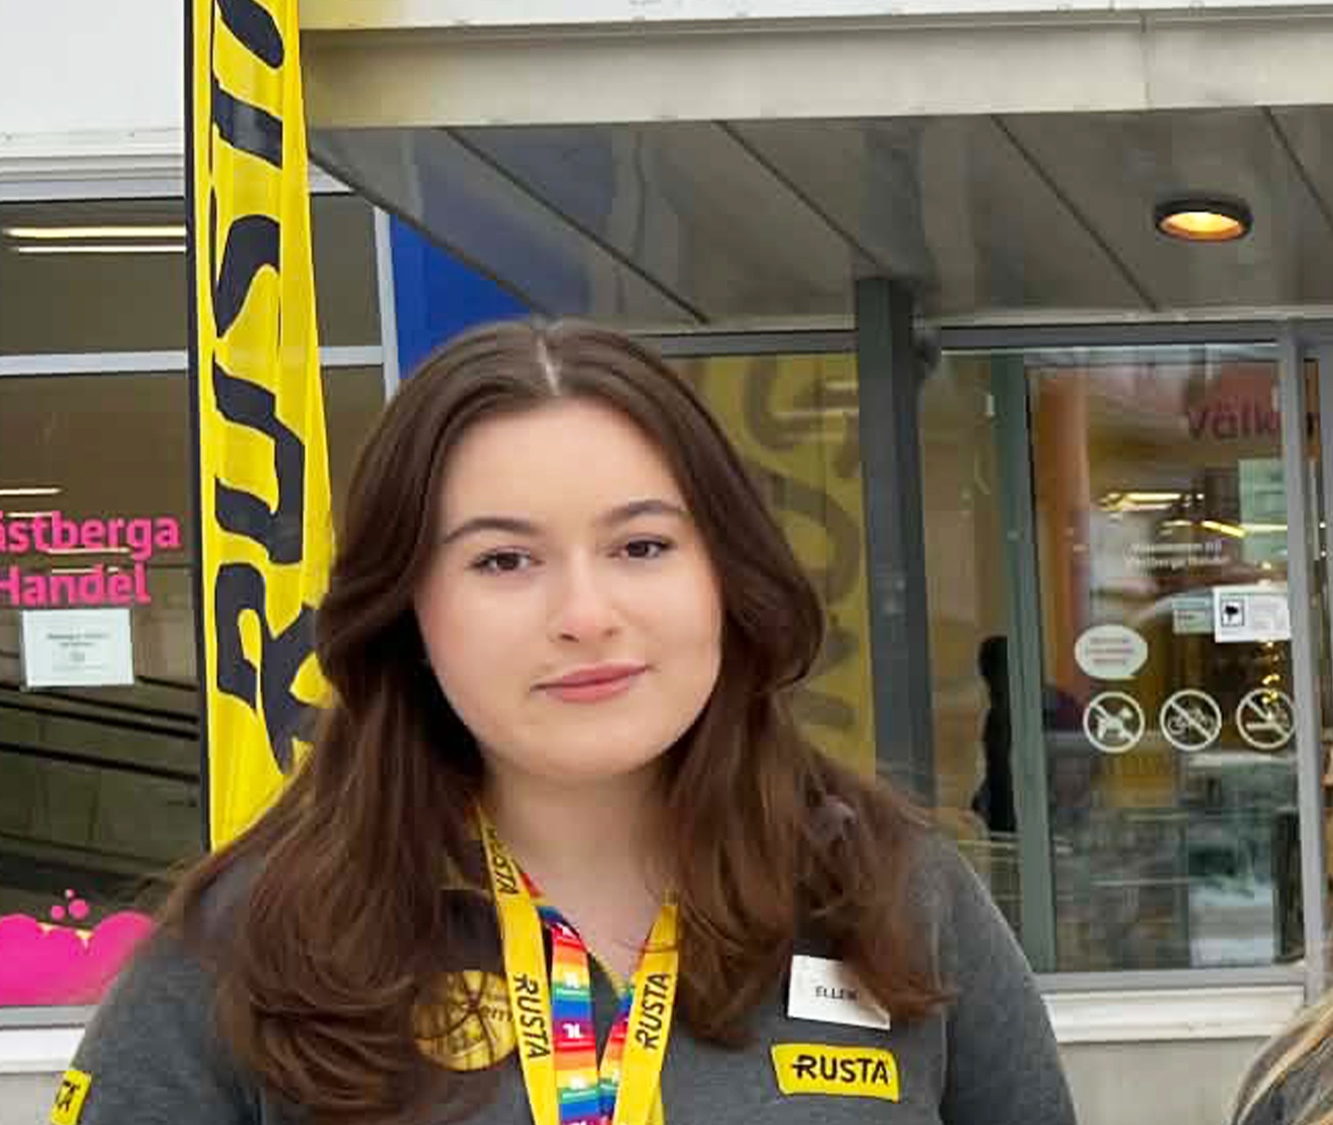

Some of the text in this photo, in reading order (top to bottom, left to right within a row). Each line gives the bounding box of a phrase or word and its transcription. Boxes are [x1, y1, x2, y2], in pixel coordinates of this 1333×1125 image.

[0, 511, 180, 561] stberga
[513, 973, 550, 1059] RUSTA
[635, 972, 671, 1050] RUSTA
[793, 1054, 889, 1085] RUSTA
